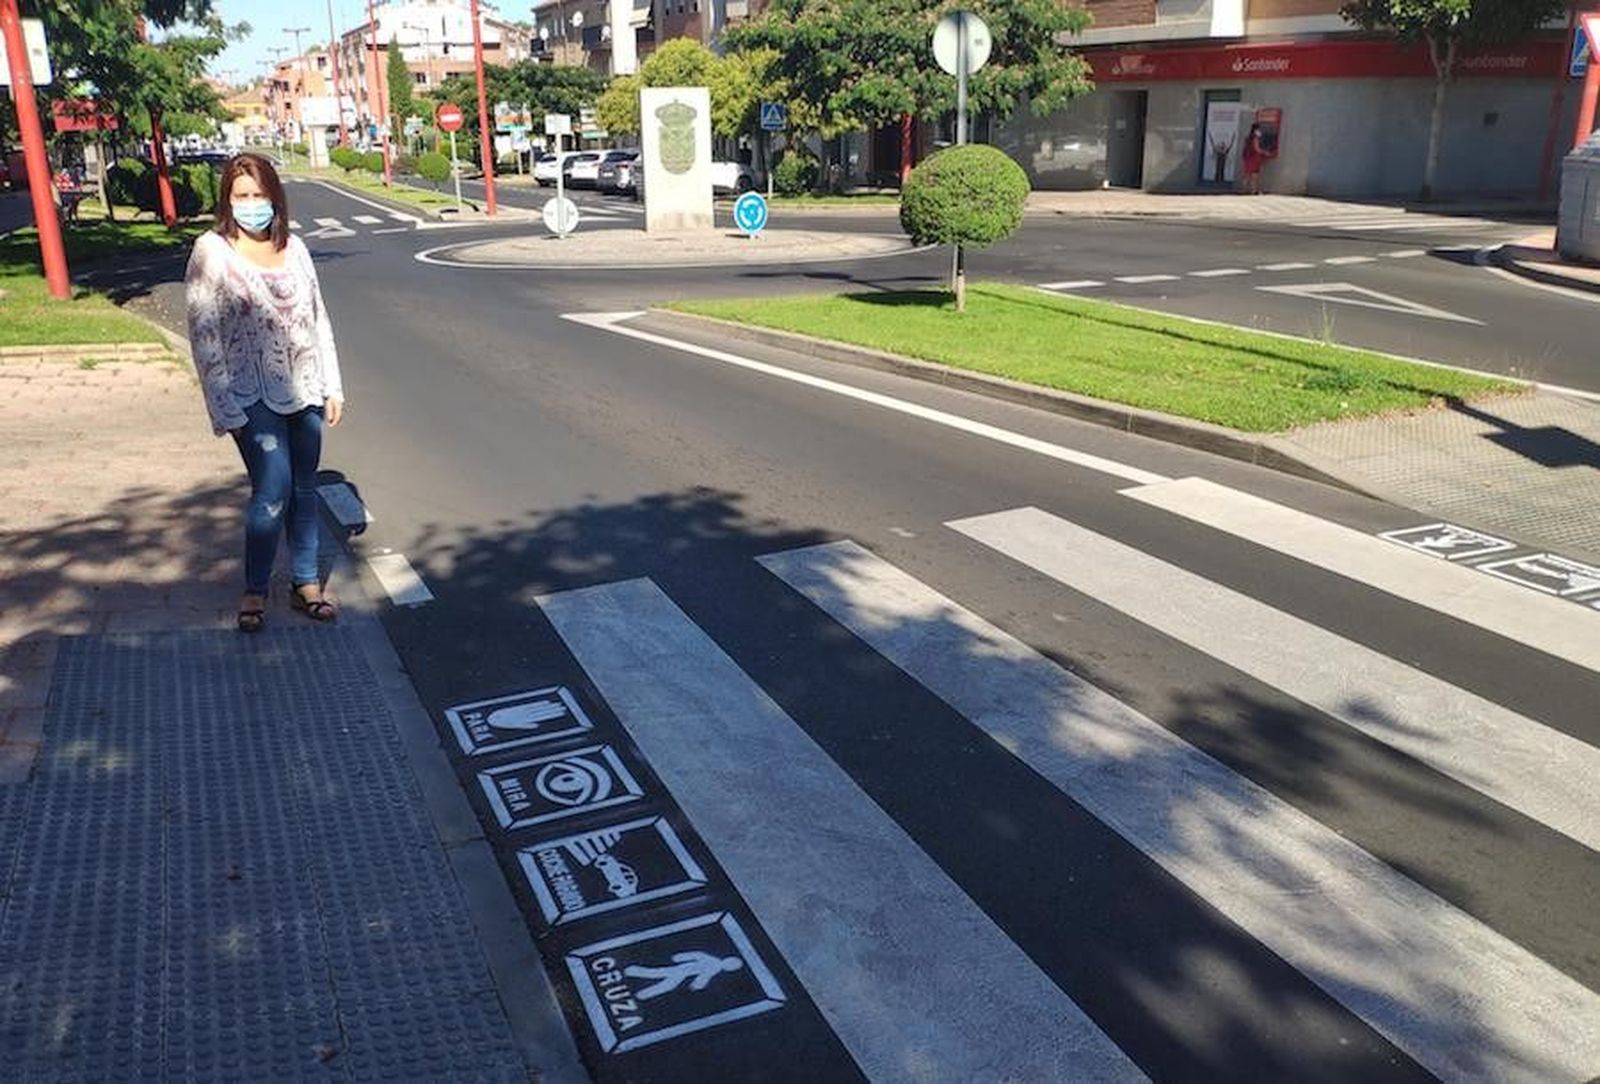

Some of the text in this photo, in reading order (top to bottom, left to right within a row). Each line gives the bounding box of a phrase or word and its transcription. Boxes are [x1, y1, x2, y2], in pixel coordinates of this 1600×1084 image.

[463, 712, 494, 742] PARA
[499, 778, 532, 812] MIRA
[592, 957, 643, 1031] CRUZA
